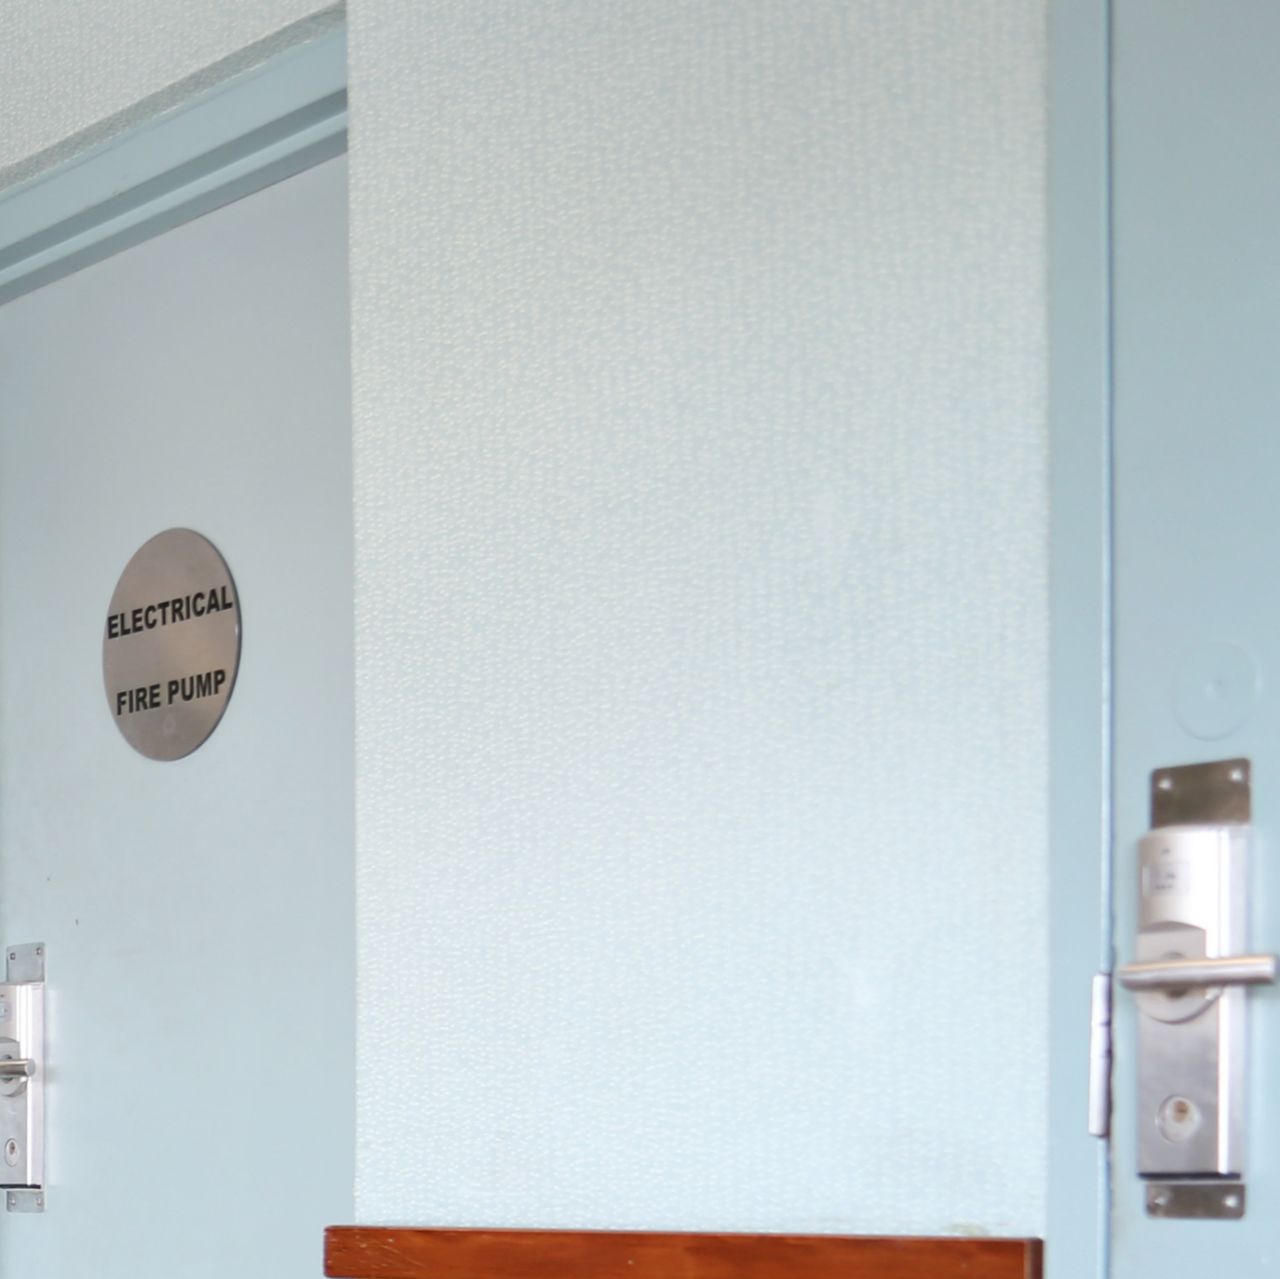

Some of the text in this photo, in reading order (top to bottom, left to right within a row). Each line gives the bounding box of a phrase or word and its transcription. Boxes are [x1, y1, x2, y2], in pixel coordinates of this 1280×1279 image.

[107, 585, 233, 639] ELECTRICAL
[116, 669, 226, 715] FIRE PUMP
